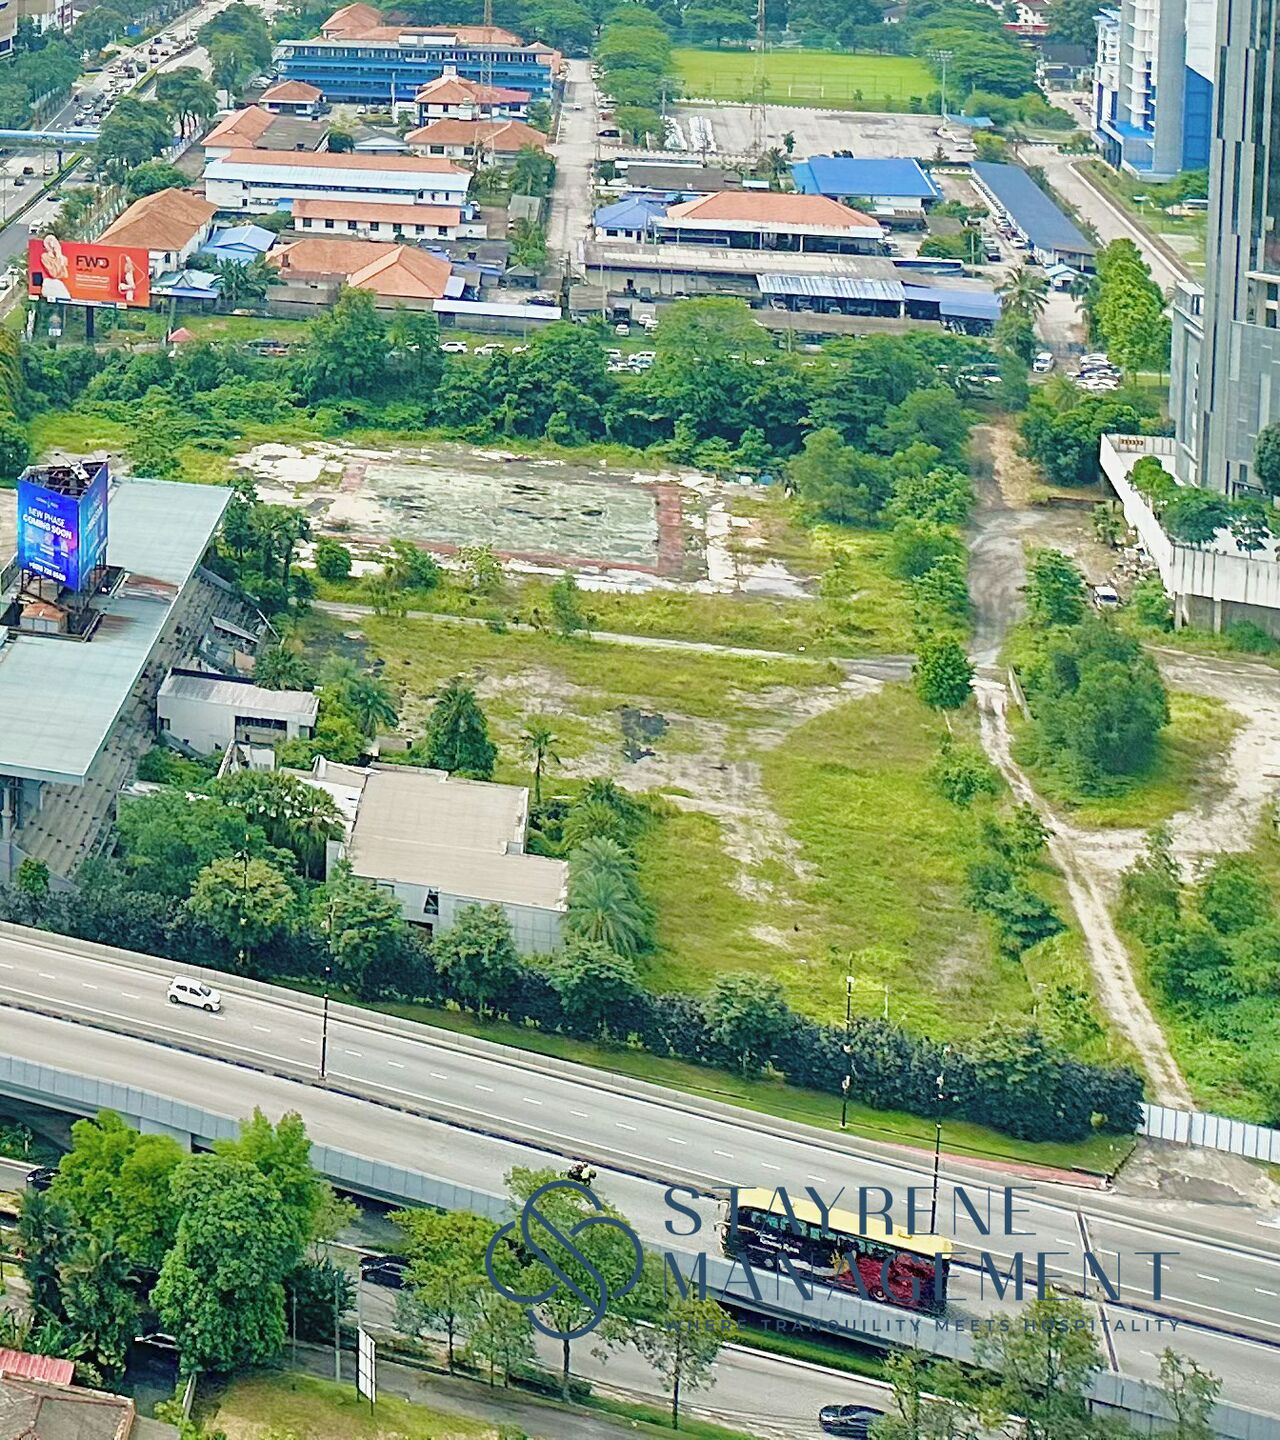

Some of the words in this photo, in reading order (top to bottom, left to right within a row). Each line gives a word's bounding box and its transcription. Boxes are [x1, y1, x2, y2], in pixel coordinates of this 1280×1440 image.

[76, 255, 110, 268] FWD
[22, 513, 51, 532] COMING
[50, 524, 73, 540] SOON
[28, 506, 43, 519] NEW
[43, 511, 66, 528] PHASE
